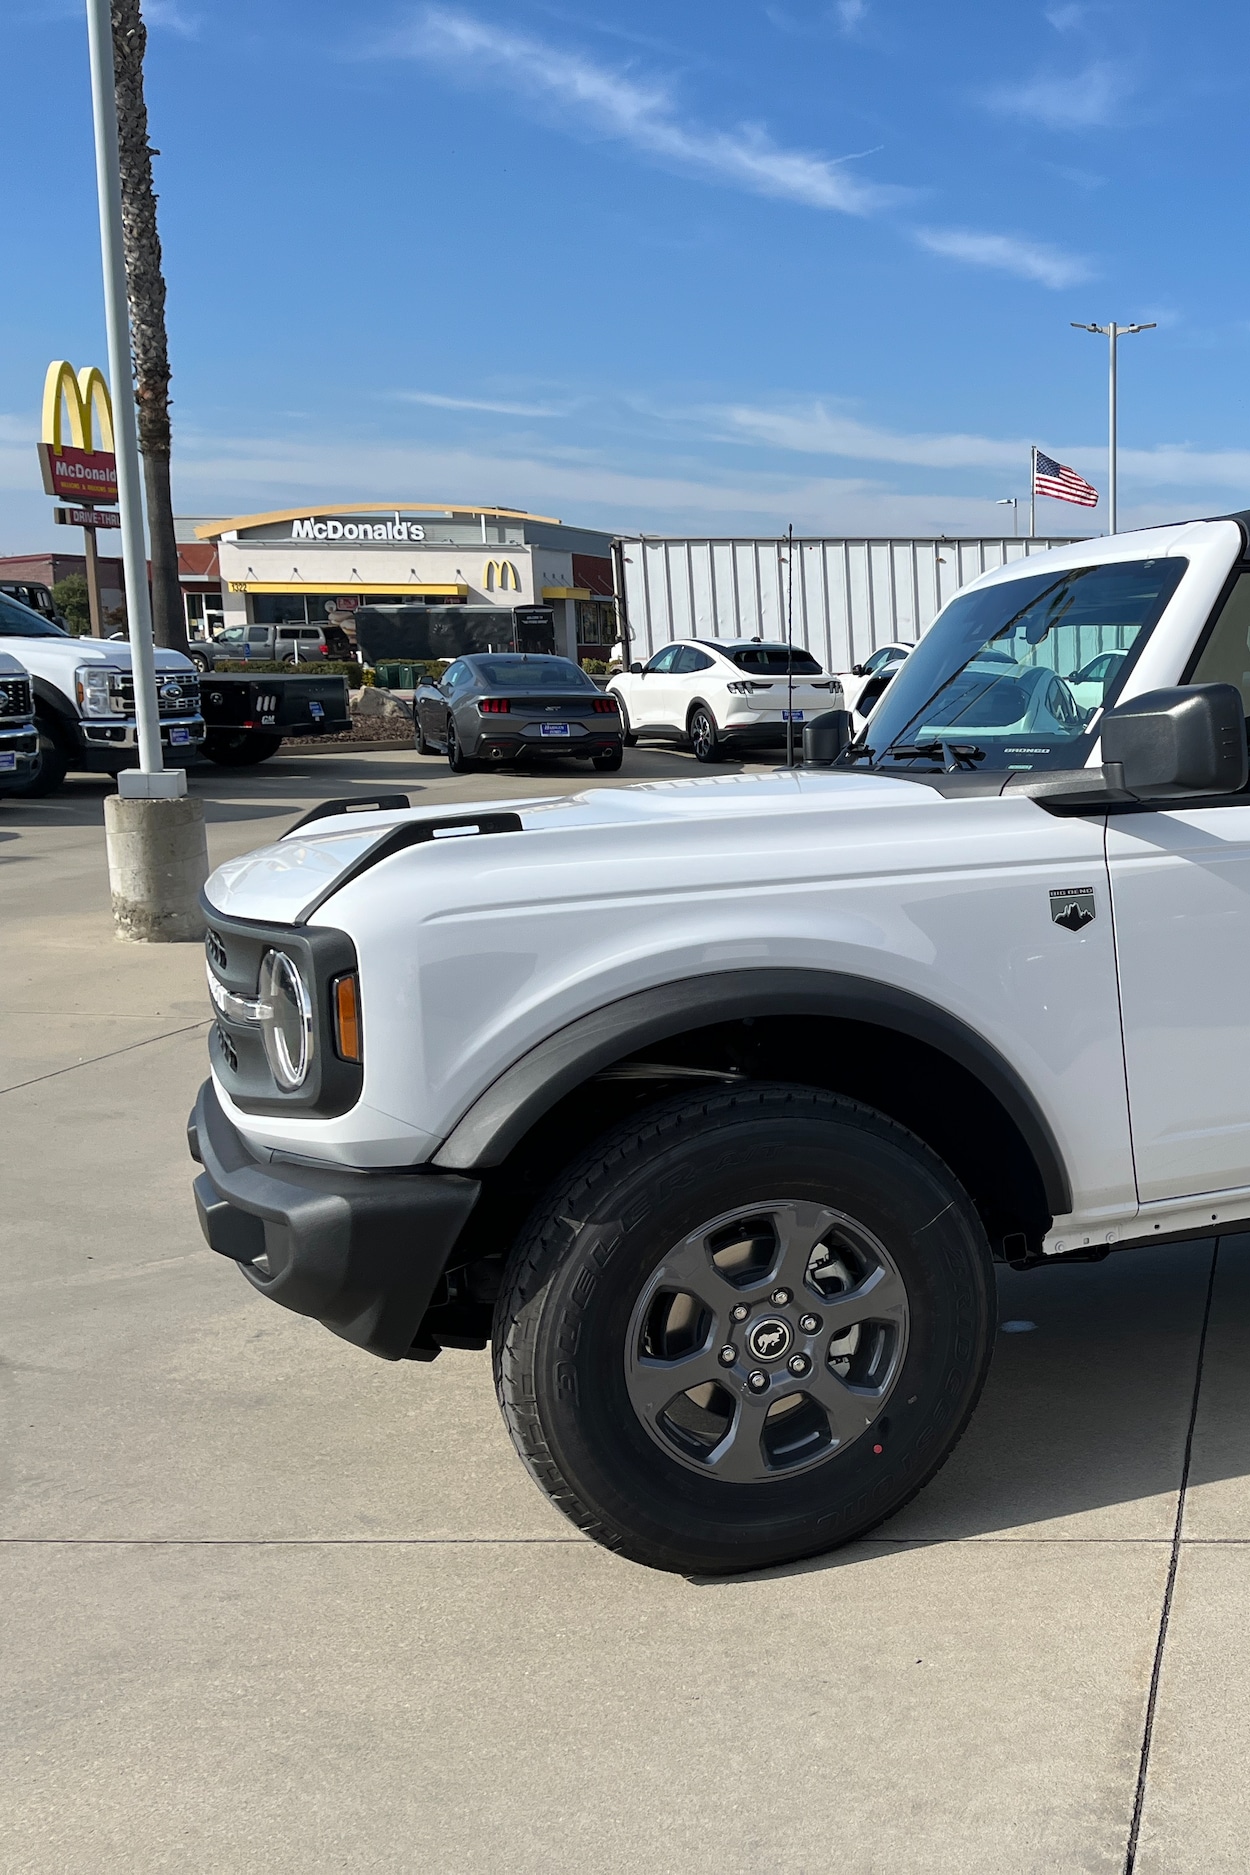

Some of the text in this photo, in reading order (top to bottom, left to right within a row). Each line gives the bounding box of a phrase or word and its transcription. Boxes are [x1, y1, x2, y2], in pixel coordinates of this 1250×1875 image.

[55, 460, 117, 483] McDonald
[291, 517, 425, 540] McDonald's
[1067, 888, 1093, 896] BEND
[553, 1161, 698, 1408] DUELER
